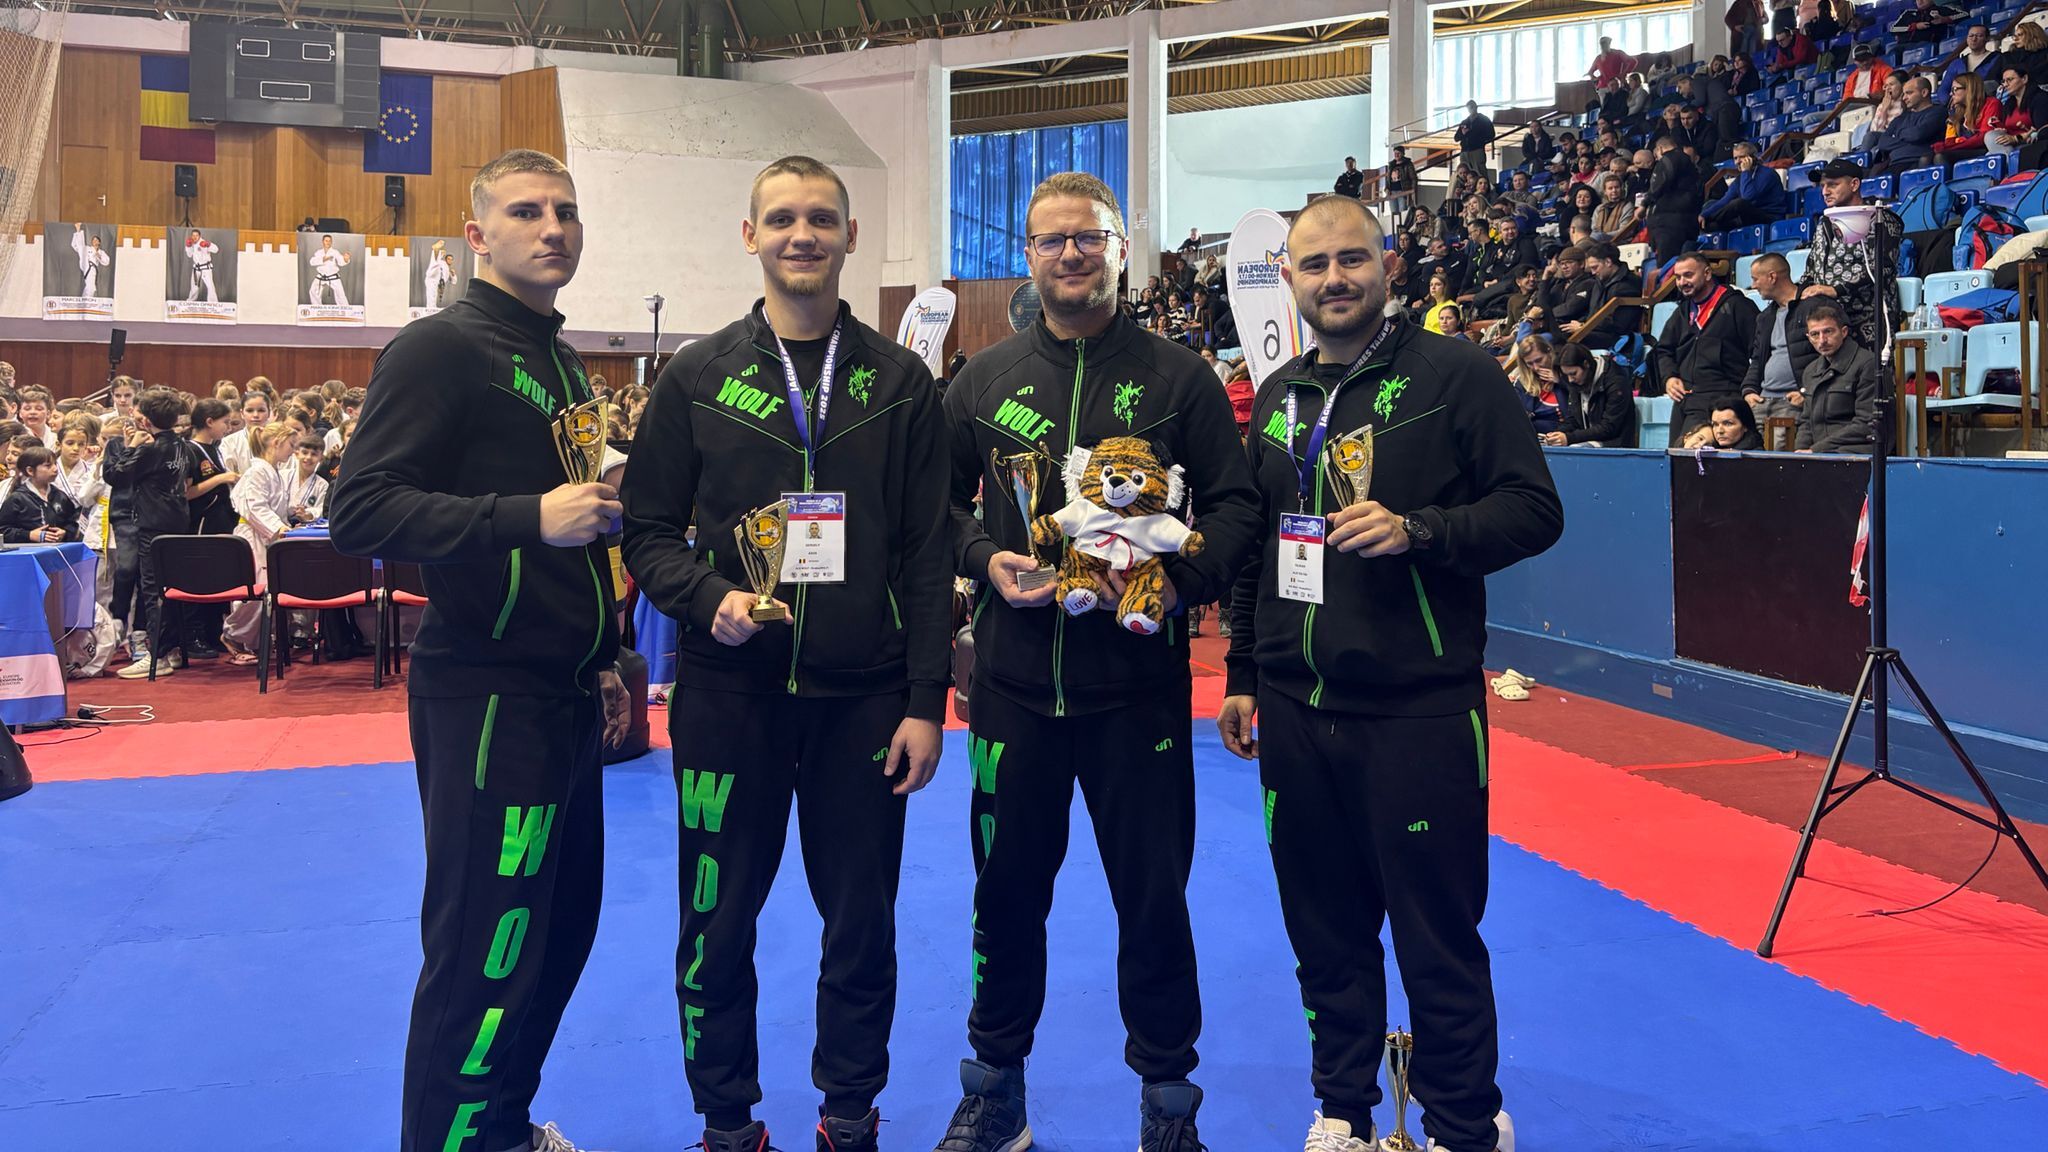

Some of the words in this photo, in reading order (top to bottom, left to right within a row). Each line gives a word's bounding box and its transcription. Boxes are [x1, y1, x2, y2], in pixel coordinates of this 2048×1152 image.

[1953, 282, 1959, 291] 3
[821, 328, 841, 393] CHAMPIONSHIP
[918, 339, 929, 359] 3
[513, 365, 557, 416] WOLF
[716, 376, 785, 420] WOLF
[994, 398, 1056, 441] WOLF
[1069, 593, 1093, 611] LOVE
[682, 768, 735, 1060] WOLF
[443, 804, 557, 1152] WOLF
